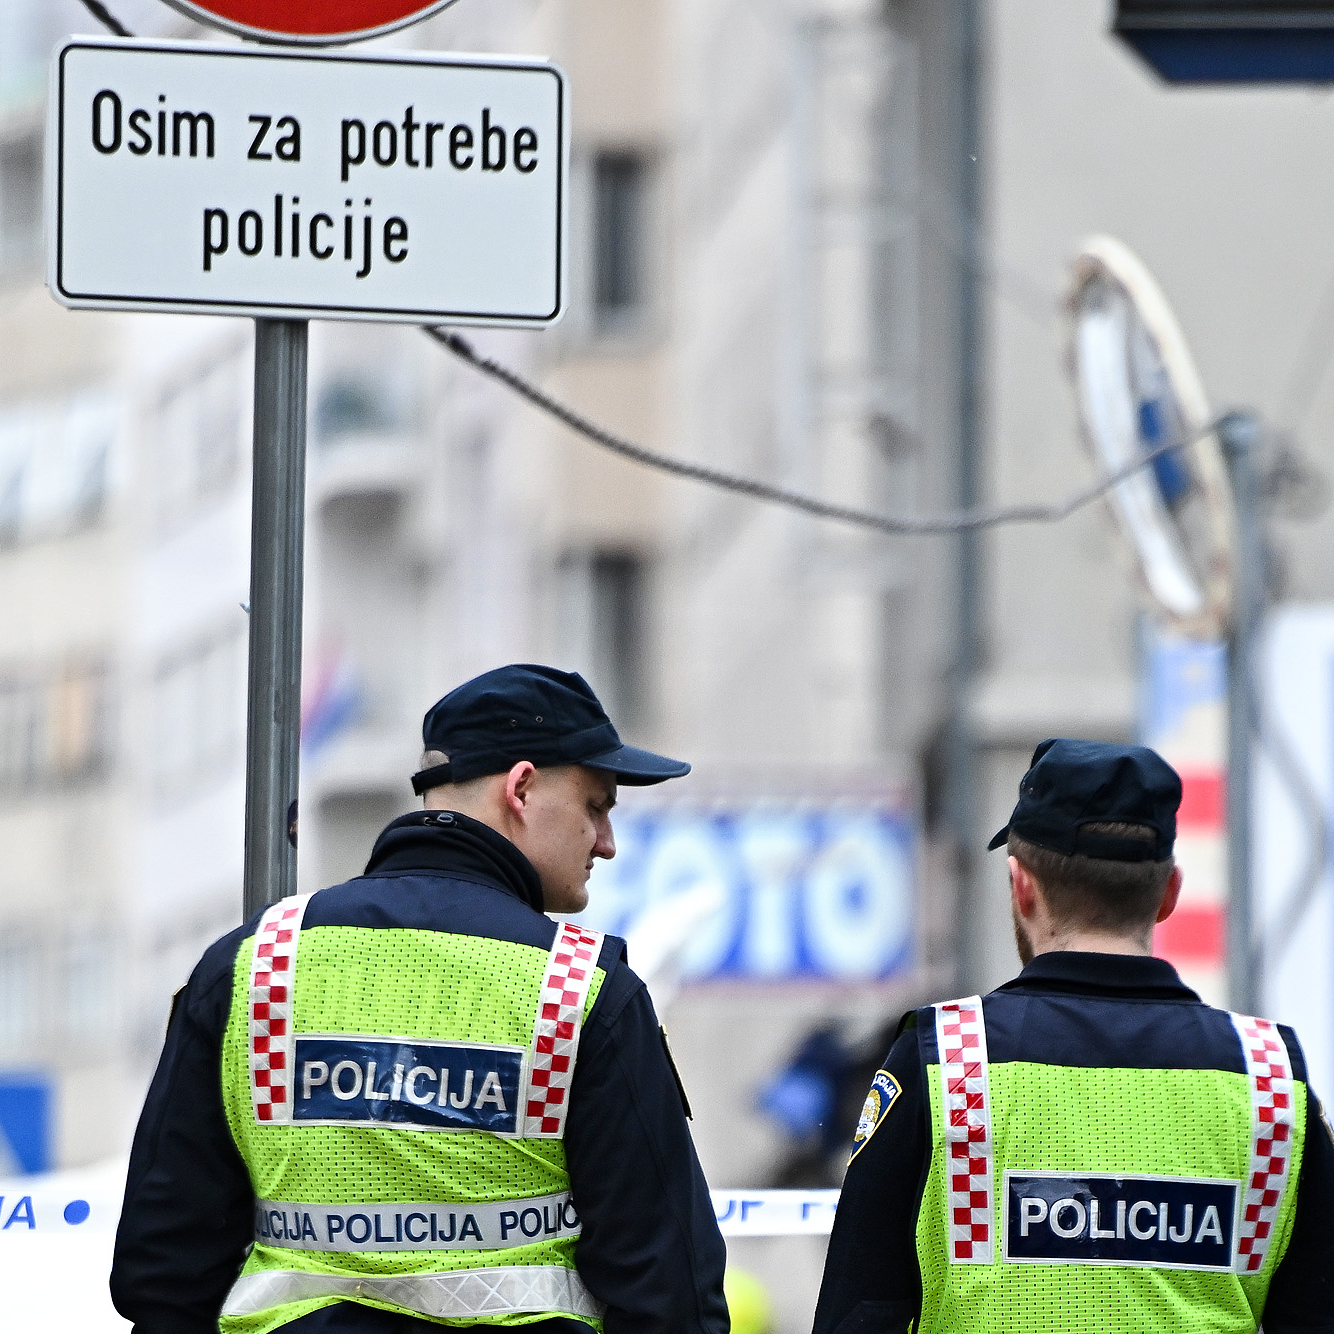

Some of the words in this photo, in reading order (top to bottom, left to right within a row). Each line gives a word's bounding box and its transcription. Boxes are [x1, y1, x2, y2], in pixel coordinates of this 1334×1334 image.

[91, 89, 215, 158] Osim
[247, 114, 301, 162] za
[340, 105, 538, 182] potrebe
[202, 193, 409, 279] policije
[302, 1060, 507, 1111] POLICIJA
[326, 1212, 484, 1244] POLICIJA
[1020, 1197, 1223, 1245] POLICIJA
